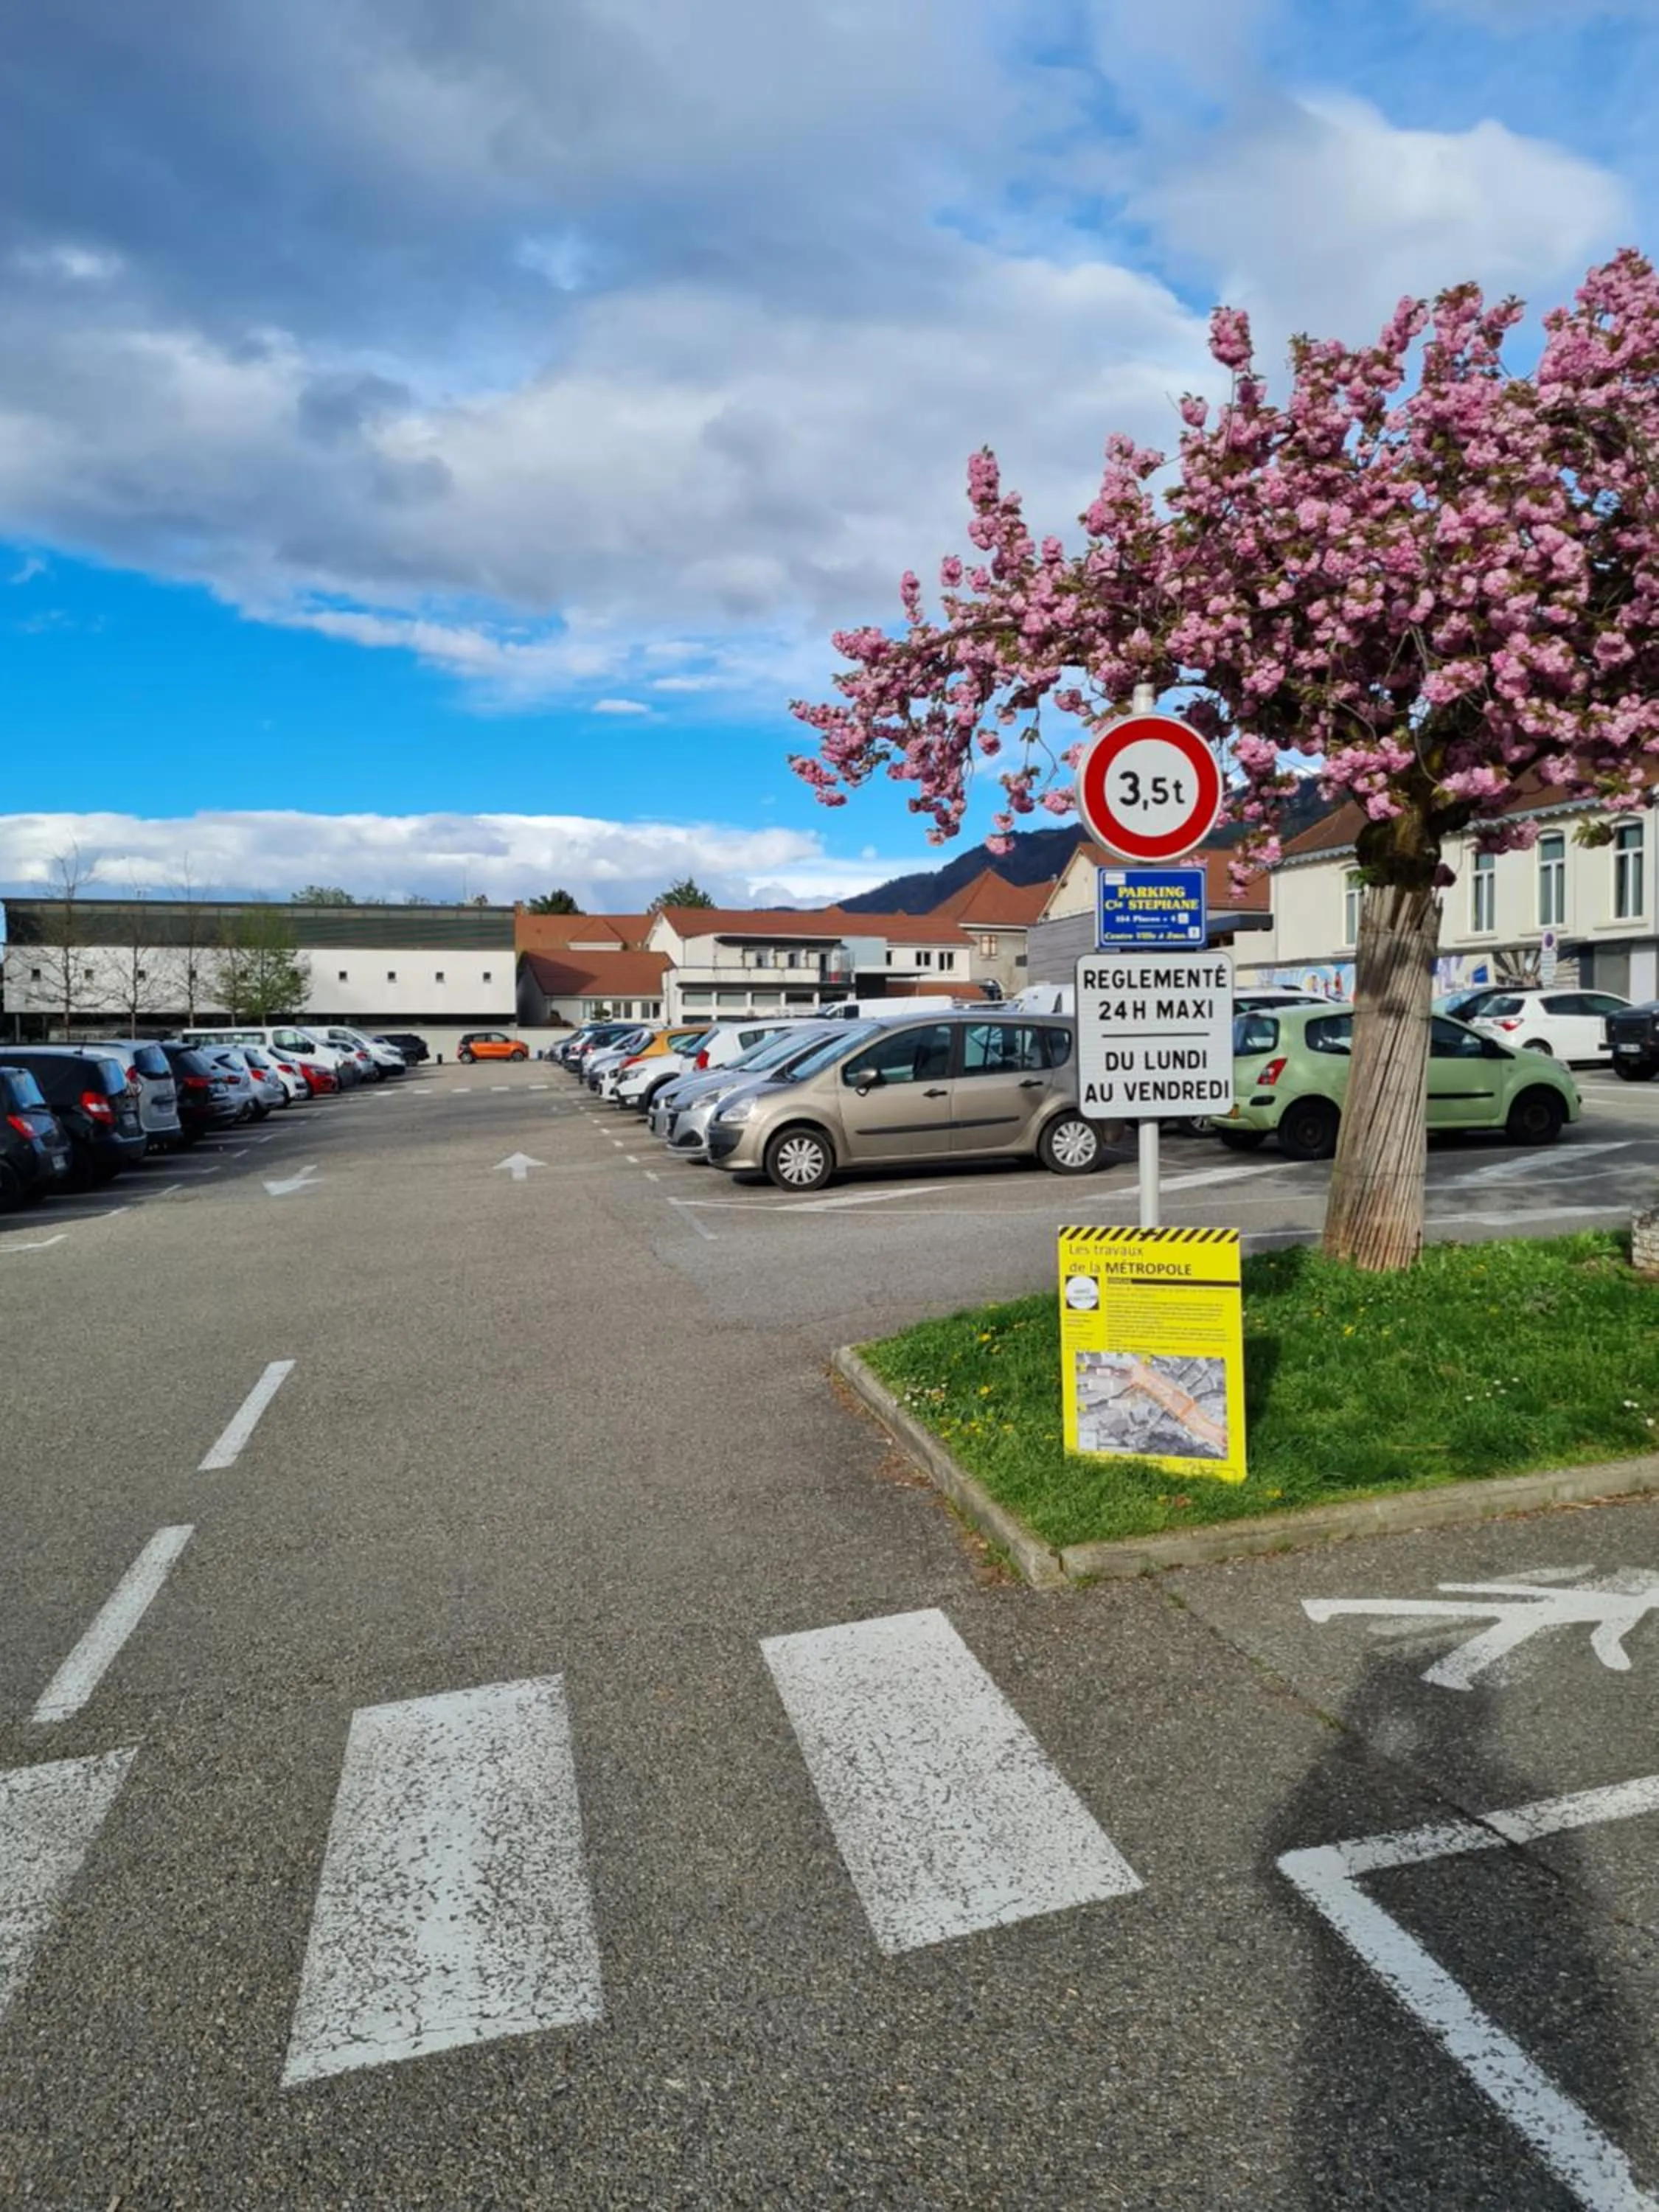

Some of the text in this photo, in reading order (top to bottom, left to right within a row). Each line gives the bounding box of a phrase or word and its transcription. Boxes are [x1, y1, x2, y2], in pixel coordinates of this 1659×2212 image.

[1119, 771, 1185, 810] 3,5t
[1118, 886, 1185, 898] PARKING
[1128, 899, 1199, 911] STEPHANE
[1083, 964, 1228, 990] REGLEMENTÉ
[1156, 999, 1213, 1019] MAXI
[1105, 1049, 1207, 1071] DU LUNDI
[1085, 1080, 1229, 1103] AU VENDREDI
[1069, 1244, 1143, 1256] Les travaux
[1069, 1259, 1192, 1276] de la MÉTROPOLE
